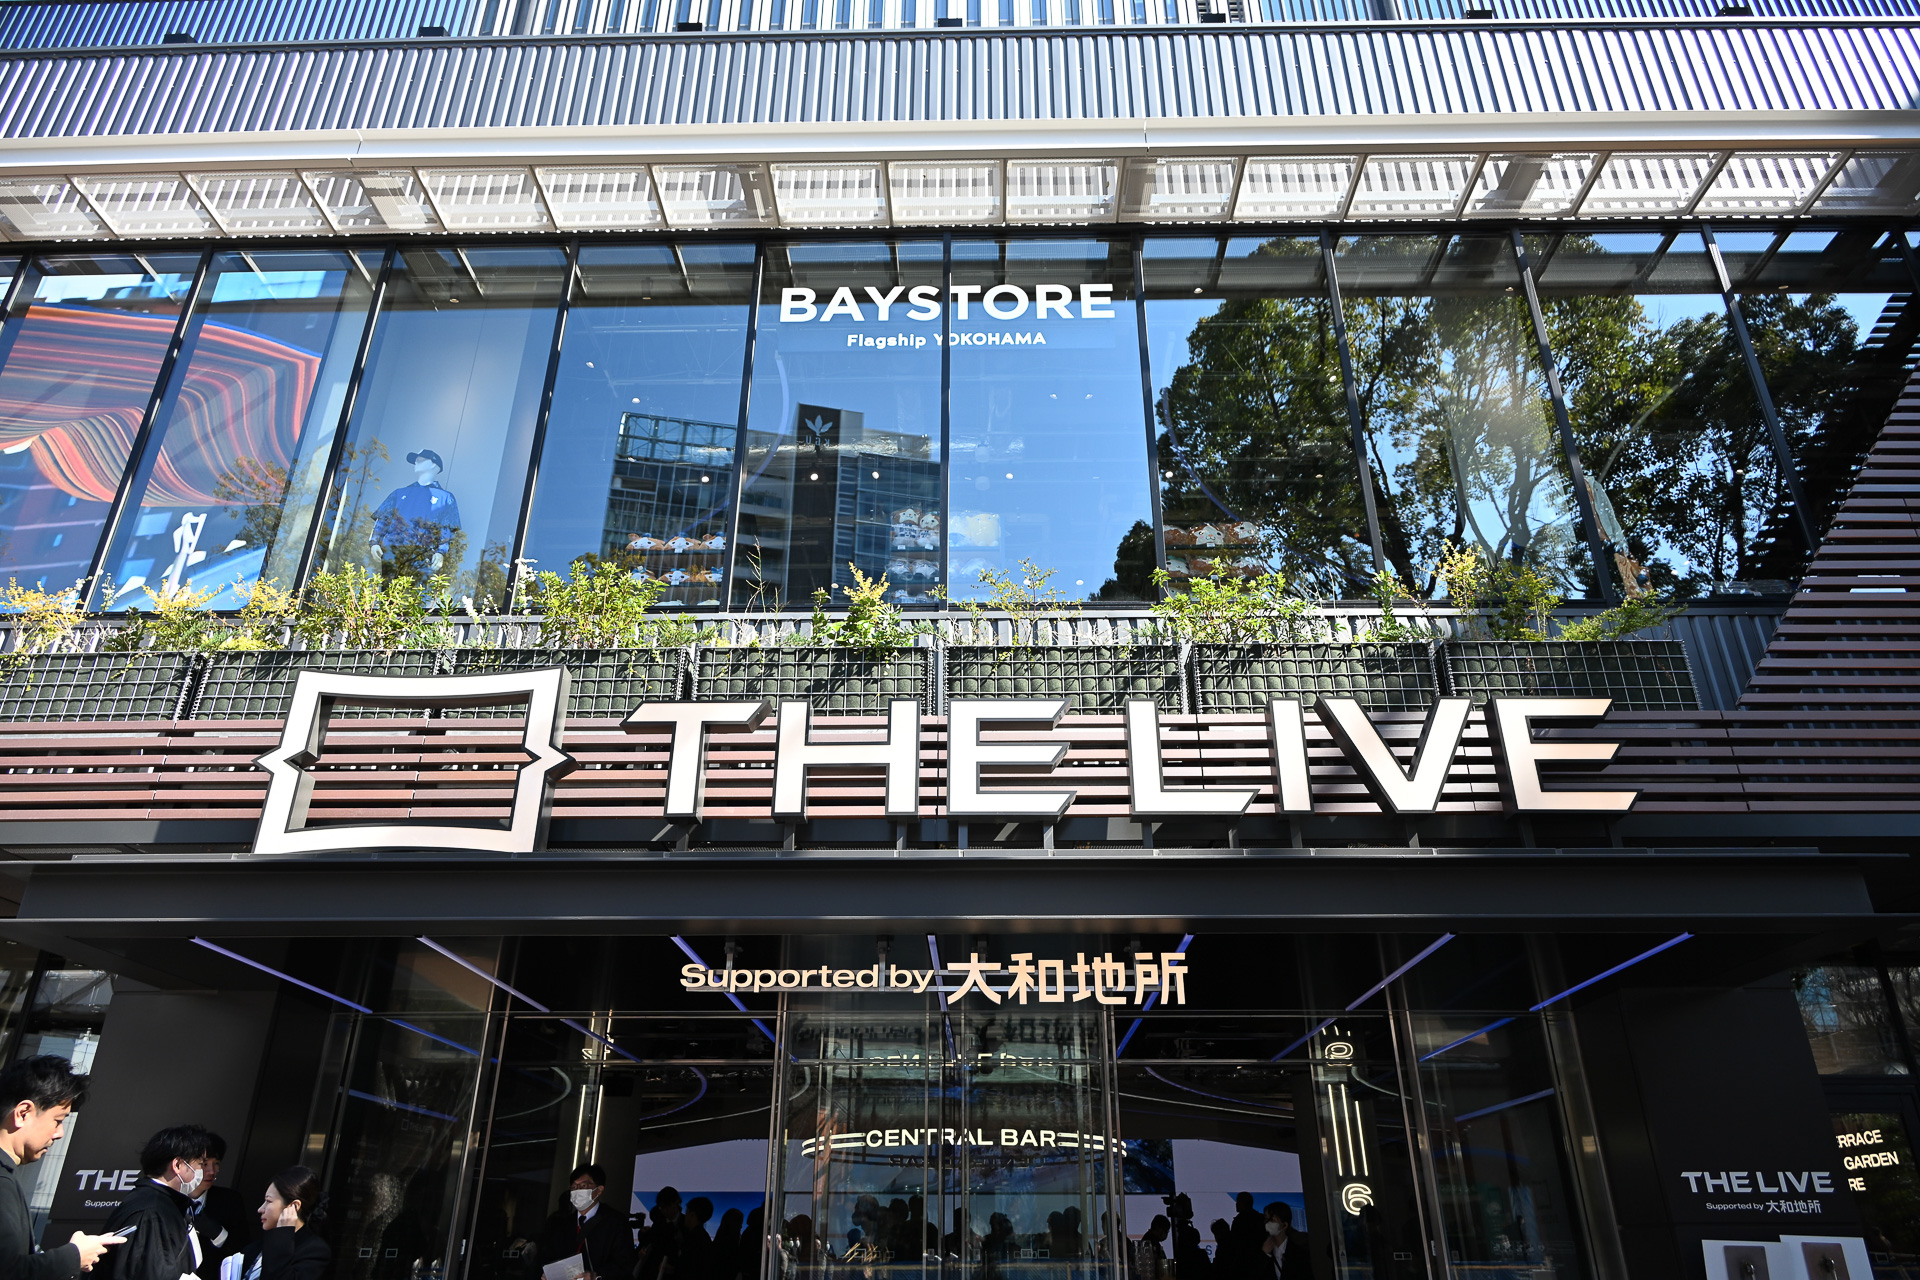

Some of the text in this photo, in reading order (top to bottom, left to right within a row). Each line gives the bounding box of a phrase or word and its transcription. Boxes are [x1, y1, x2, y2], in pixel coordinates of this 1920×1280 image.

[779, 283, 1116, 323] BAYSTORE
[847, 332, 1047, 350] Flagship YOKOHAMA
[619, 697, 1644, 823] THE LIVE
[680, 952, 1189, 1005] Supported by 大和地所
[865, 1129, 1056, 1147] CENTRAL BAR
[1836, 1129, 1884, 1148] RRACE
[1843, 1150, 1900, 1170] GARDEN
[75, 1169, 142, 1191] THE
[1680, 1171, 1835, 1193] THE LIVE
[1705, 1200, 1822, 1213] Supported by 大和地所
